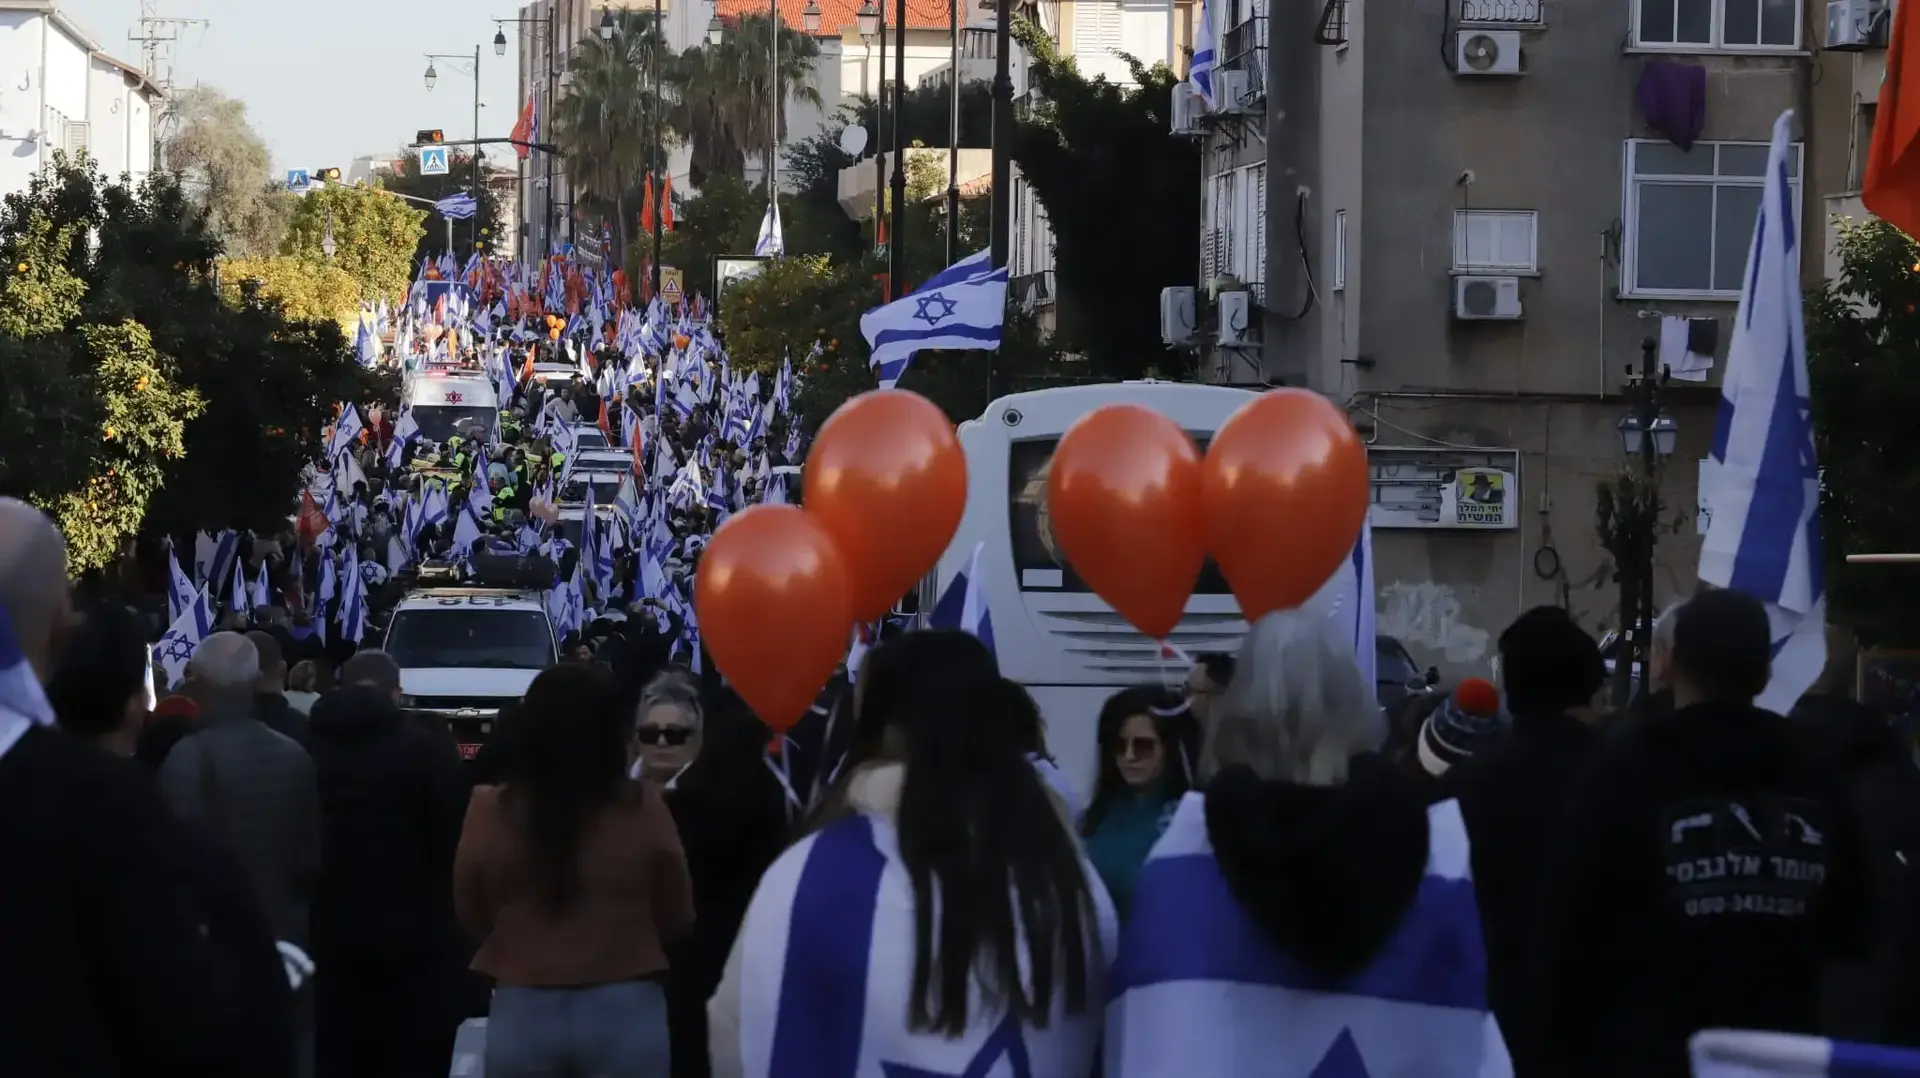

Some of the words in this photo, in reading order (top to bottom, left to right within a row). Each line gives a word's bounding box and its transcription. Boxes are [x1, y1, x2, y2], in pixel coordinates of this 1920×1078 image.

[1459, 505, 1485, 513] המלך
[1487, 505, 1503, 513] יחי
[1459, 513, 1502, 522] המשיח
